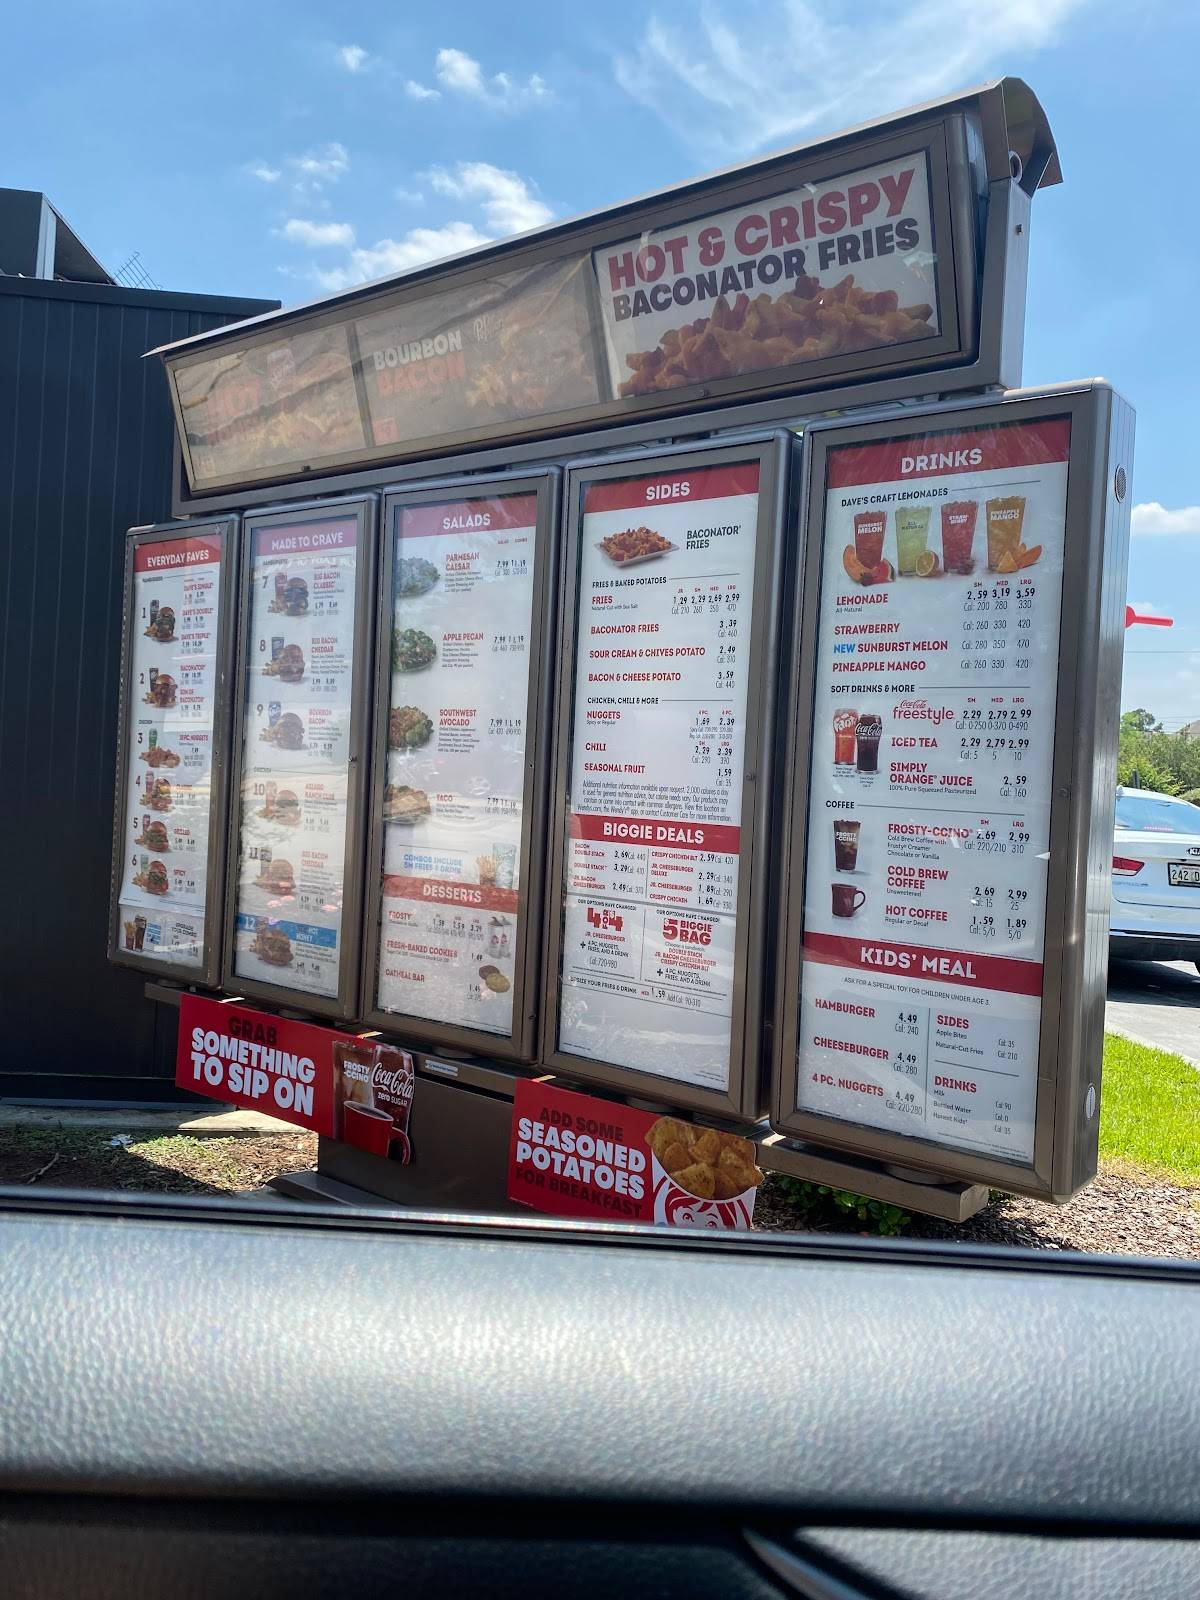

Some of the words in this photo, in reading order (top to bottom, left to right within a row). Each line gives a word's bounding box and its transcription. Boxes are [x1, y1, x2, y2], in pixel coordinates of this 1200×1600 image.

[607, 235, 688, 291] HOT
[698, 227, 726, 266] &
[734, 169, 915, 256] CRISPY
[818, 217, 920, 270] FRIES
[374, 330, 462, 370] BOURBON
[376, 352, 465, 398] BACON
[901, 448, 982, 473] DRINKS
[646, 482, 690, 501] SIDES
[841, 496, 868, 507] DAVE'S
[870, 493, 897, 504] CRAFT
[898, 488, 948, 502] LEMONADES
[443, 514, 490, 529] SALADS
[991, 512, 1019, 521] MANGO
[858, 526, 883, 534] MELON
[272, 536, 297, 550] MADE
[299, 536, 310, 546] TO
[312, 532, 343, 545] CRAVE
[686, 540, 710, 550] FRIES
[148, 552, 185, 567] EVERYDAY
[187, 550, 209, 563] FAVES
[446, 562, 470, 571] CAESAR
[263, 576, 268, 588] 7
[592, 580, 609, 588] FRIES
[616, 578, 635, 587] BAKED
[636, 576, 667, 586] POTATOES
[592, 596, 613, 604] FRIES
[725, 594, 740, 602] 2.99
[836, 594, 888, 606] LEMONADE
[967, 590, 988, 601] 2.59
[992, 588, 1010, 598] 3.19
[1016, 588, 1035, 599] 3.59
[591, 625, 636, 634] BACONATOR
[638, 624, 659, 633] FRIES
[720, 619, 737, 628] 3.39
[834, 623, 900, 635] STRAWBERRY
[443, 633, 462, 641] APPLE
[260, 640, 266, 652] 8
[719, 646, 736, 654] 2.49
[834, 643, 855, 654] NEW
[858, 642, 910, 653] SUNBURST
[912, 641, 948, 651] MELON
[590, 649, 610, 658] SOUR
[611, 649, 638, 657] CREAM
[639, 649, 644, 657] &
[645, 648, 674, 657] CHIVES
[676, 648, 705, 656] POTATO
[832, 662, 885, 672] PINEAPPLE
[887, 661, 926, 671] MANGO
[589, 673, 615, 681] BACON
[616, 673, 621, 681] &
[622, 673, 651, 681] CHEESE
[653, 673, 681, 681] POTATO
[718, 672, 734, 680] 3.59
[831, 685, 850, 693] SOFT
[851, 685, 883, 693] DRINKS
[891, 685, 915, 693] MORE
[257, 704, 263, 716] 9
[440, 709, 477, 717] SOUTHWEST
[587, 711, 621, 719] NUGGETS
[893, 707, 954, 724] freestyle
[963, 710, 982, 720] 2.29
[988, 710, 1008, 720] 2.79
[1011, 710, 1032, 720] 2.99
[439, 718, 469, 726] AVOCADO
[720, 718, 735, 726] 2.39
[585, 743, 606, 751] CHILI
[892, 738, 917, 747] ICED
[919, 738, 938, 748] TEA
[961, 738, 981, 748] 2.29
[986, 739, 1005, 748] 2.79
[1008, 739, 1030, 749] 2.99
[718, 748, 732, 756] 3.39
[584, 763, 622, 773] SEASONAL
[624, 765, 645, 774] FRUIT
[718, 769, 732, 777] 1.59
[890, 763, 928, 773] SIMPLY
[939, 775, 973, 786] JUICE
[1004, 776, 1027, 786] 2.59
[826, 800, 854, 809] COFFEE
[134, 817, 138, 828] 5
[603, 822, 653, 839] BIGGIE
[657, 827, 704, 844] DEALS
[976, 831, 996, 840] 2.69
[1009, 832, 1030, 842] 2.99
[132, 855, 136, 866] 6
[888, 866, 916, 877] COLD
[918, 869, 948, 881] BREW
[1171, 870, 1188, 880] 242
[887, 878, 925, 890] COFFEE
[423, 884, 482, 903] DESSERTS
[886, 905, 907, 916] HOT
[910, 908, 948, 921] COFFEE
[680, 921, 712, 932] BIGGIE
[973, 916, 993, 926] 1.59
[1007, 918, 1027, 929] 1.89
[679, 930, 712, 945] BAG
[429, 946, 457, 958] COOKIES
[860, 947, 916, 969] KIDS'
[922, 955, 976, 979] MEAL
[413, 973, 424, 982] BAR
[815, 999, 875, 1018] HAMBURGER
[899, 1013, 917, 1024] 4.49
[937, 1015, 969, 1029] SIDES
[228, 1016, 277, 1044] GRAB
[814, 1036, 889, 1060] CHEESEBURGER
[192, 1028, 316, 1084] SOMETHING
[897, 1053, 916, 1063] 4.49
[344, 1060, 370, 1075] FROSTY
[191, 1052, 224, 1086] TO
[228, 1062, 269, 1099] SIP
[274, 1077, 315, 1116] ON
[812, 1073, 818, 1082] 4
[820, 1074, 836, 1086] PC.
[838, 1078, 884, 1097] NUGGETS
[934, 1076, 977, 1093] DRINKS
[377, 1092, 390, 1101] zero
[391, 1095, 408, 1106] SUGAR
[895, 1091, 915, 1102] 4.49
[540, 1107, 572, 1128] ADD
[576, 1116, 624, 1140] SOME
[518, 1117, 646, 1173] SEASONED
[516, 1142, 645, 1200] POTATOES
[516, 1166, 546, 1187] FOR
[548, 1175, 643, 1218] BREAKFAST
